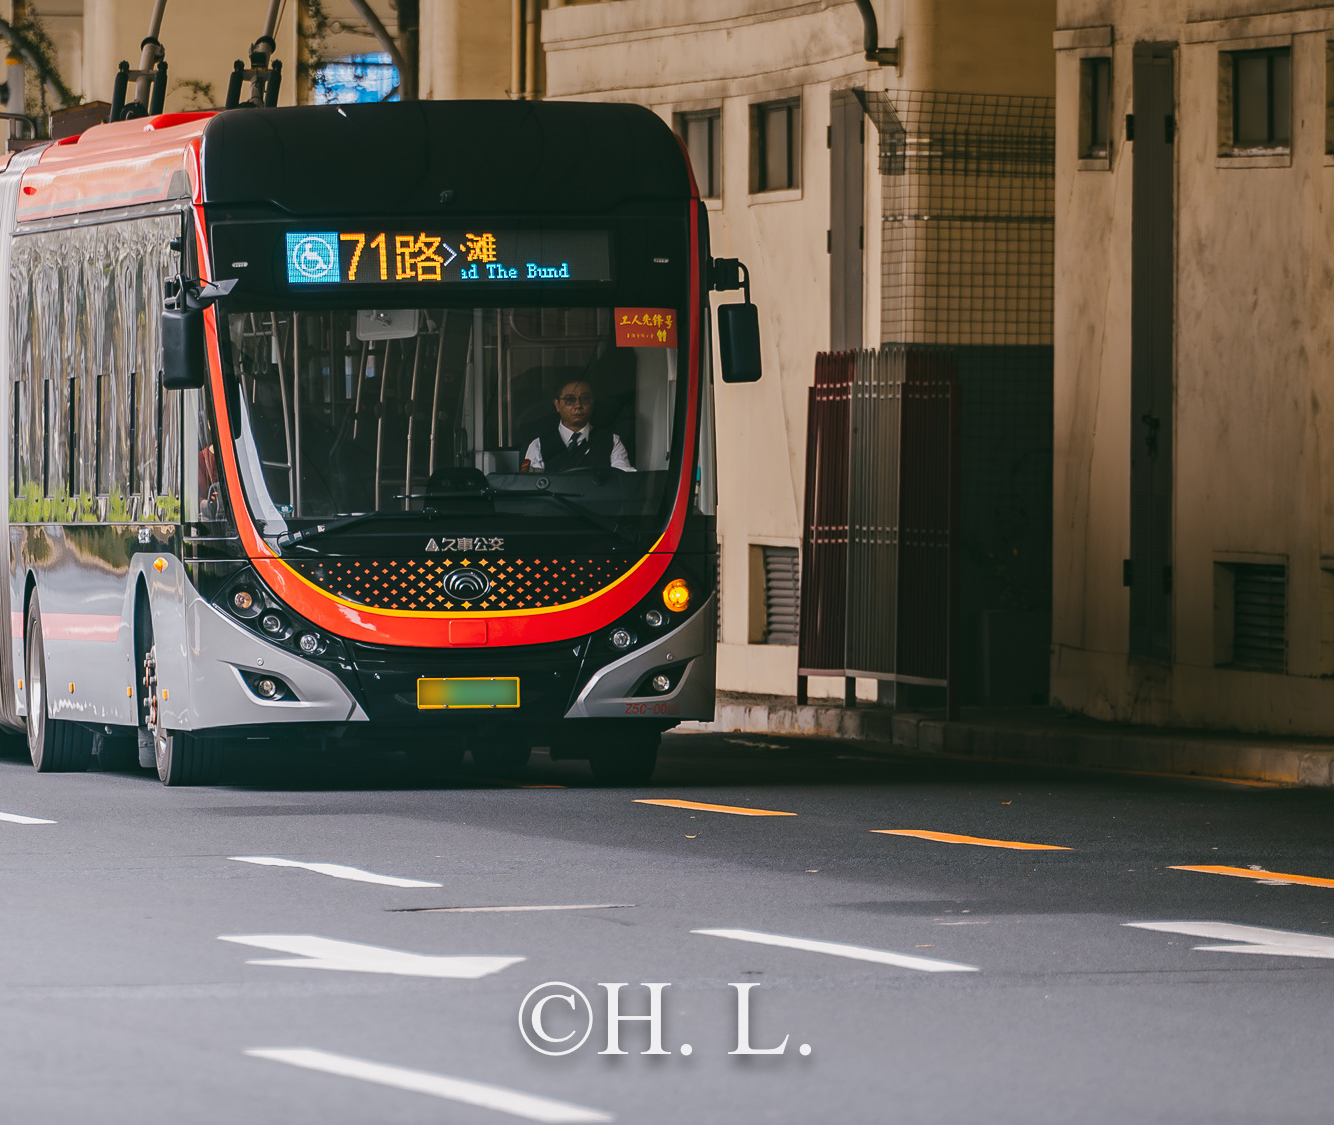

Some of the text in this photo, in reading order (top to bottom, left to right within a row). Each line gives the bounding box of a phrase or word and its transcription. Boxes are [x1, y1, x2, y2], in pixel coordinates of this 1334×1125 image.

[339, 232, 444, 281] 71路
[459, 232, 497, 263] 滩
[485, 263, 519, 280] The
[525, 262, 570, 280] Bund
[619, 313, 673, 329] 工人先锋号
